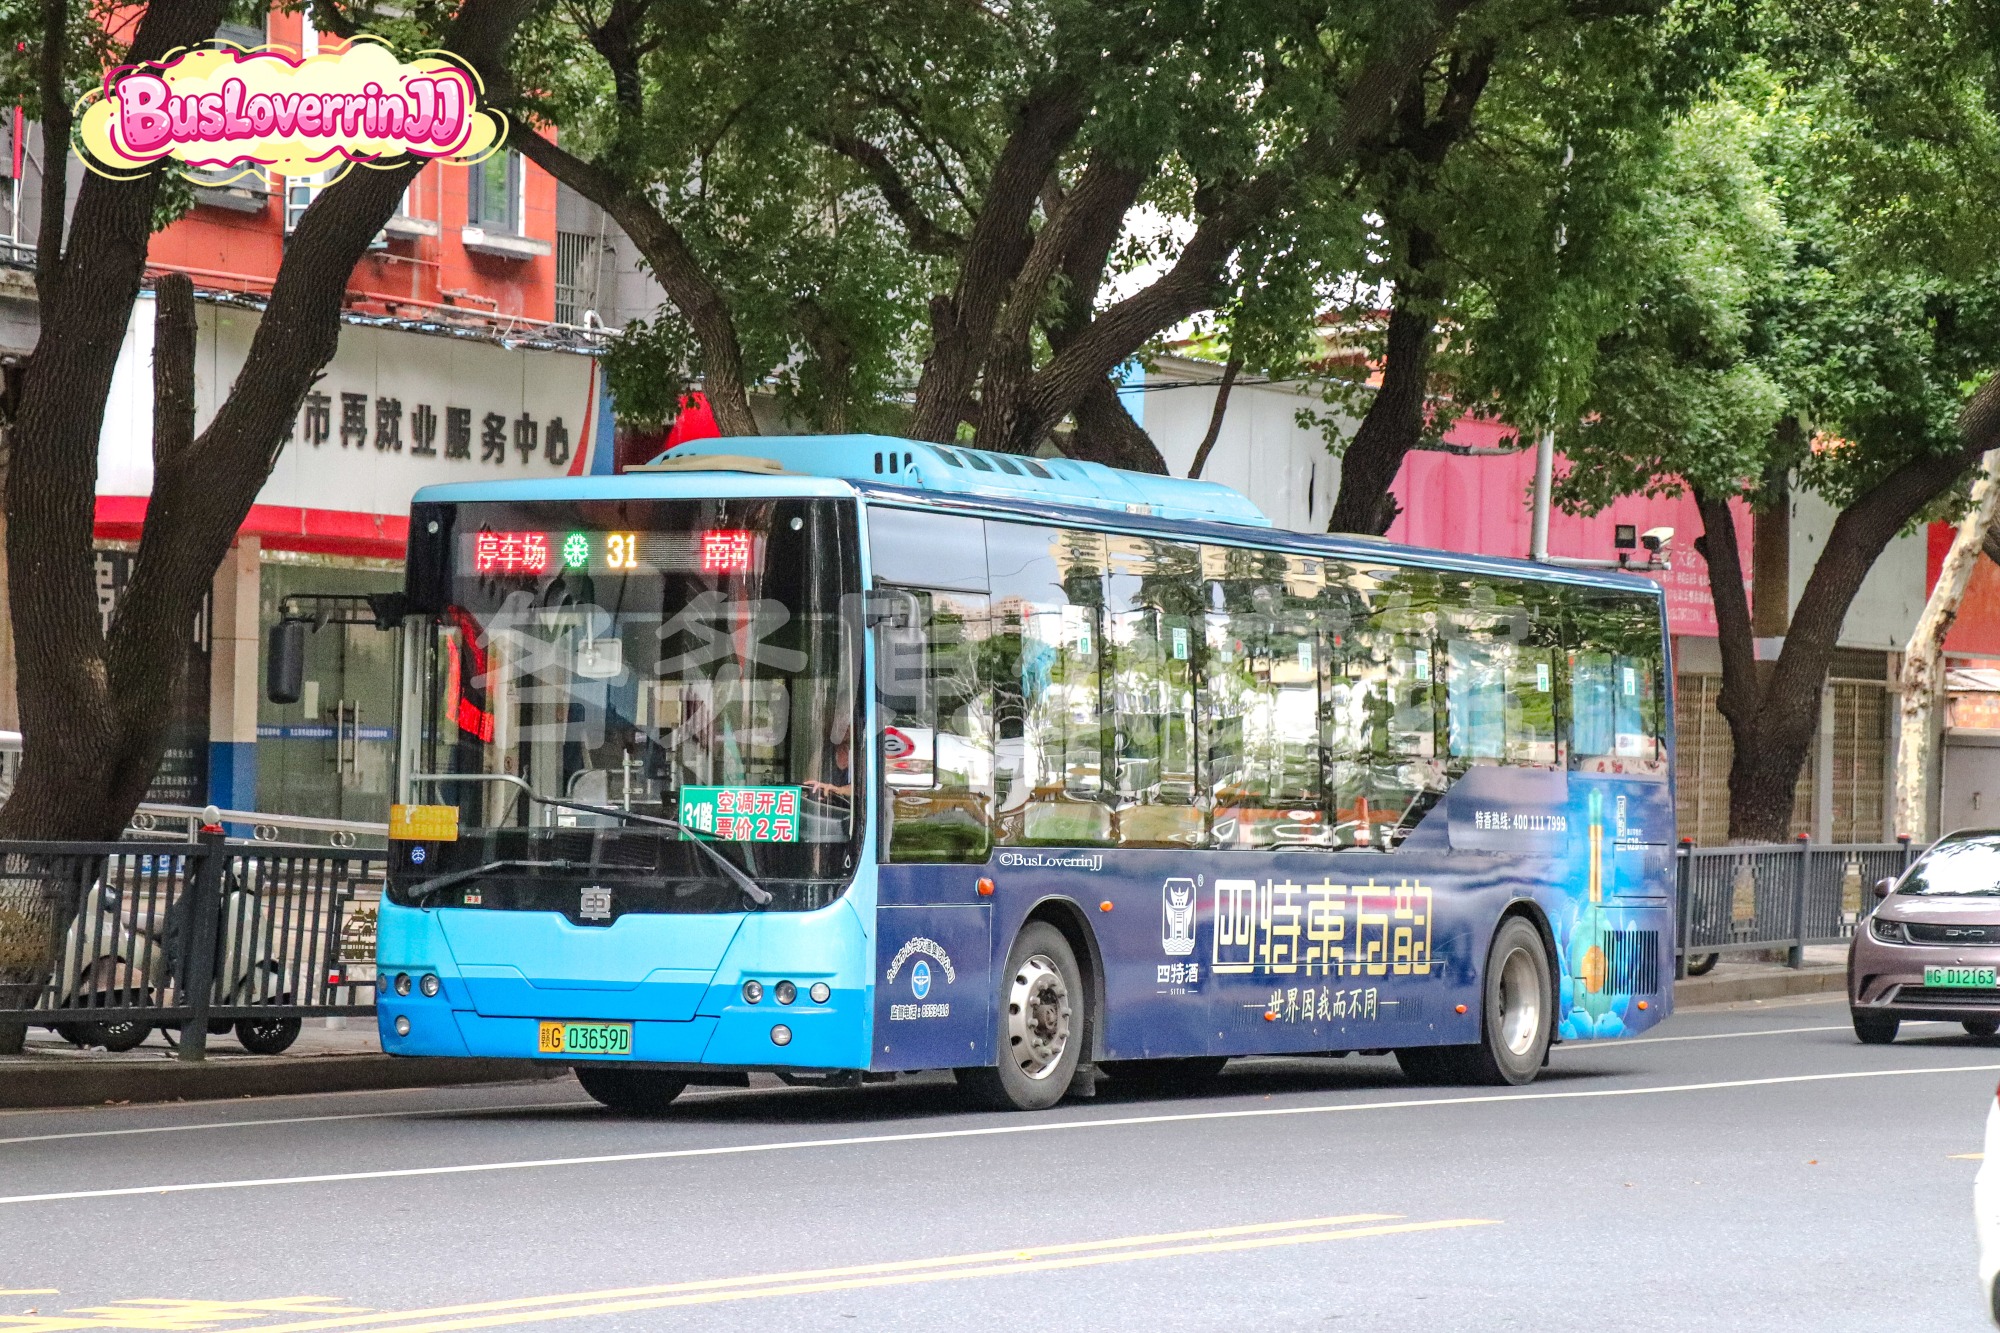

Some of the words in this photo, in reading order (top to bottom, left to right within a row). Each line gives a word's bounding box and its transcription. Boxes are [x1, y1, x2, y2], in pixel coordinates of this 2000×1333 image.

[477, 533, 546, 569] 停车场
[607, 535, 638, 568] 31
[717, 791, 794, 815] 空调开启
[715, 817, 793, 842] 票价2元
[1513, 814, 1528, 830] 400
[1530, 815, 1545, 831] 111
[1546, 816, 1567, 832] 7999
[1156, 962, 1199, 984] 四特酒
[1268, 986, 1378, 1023] 世界因我而不同
[569, 1028, 629, 1049] 03659D
